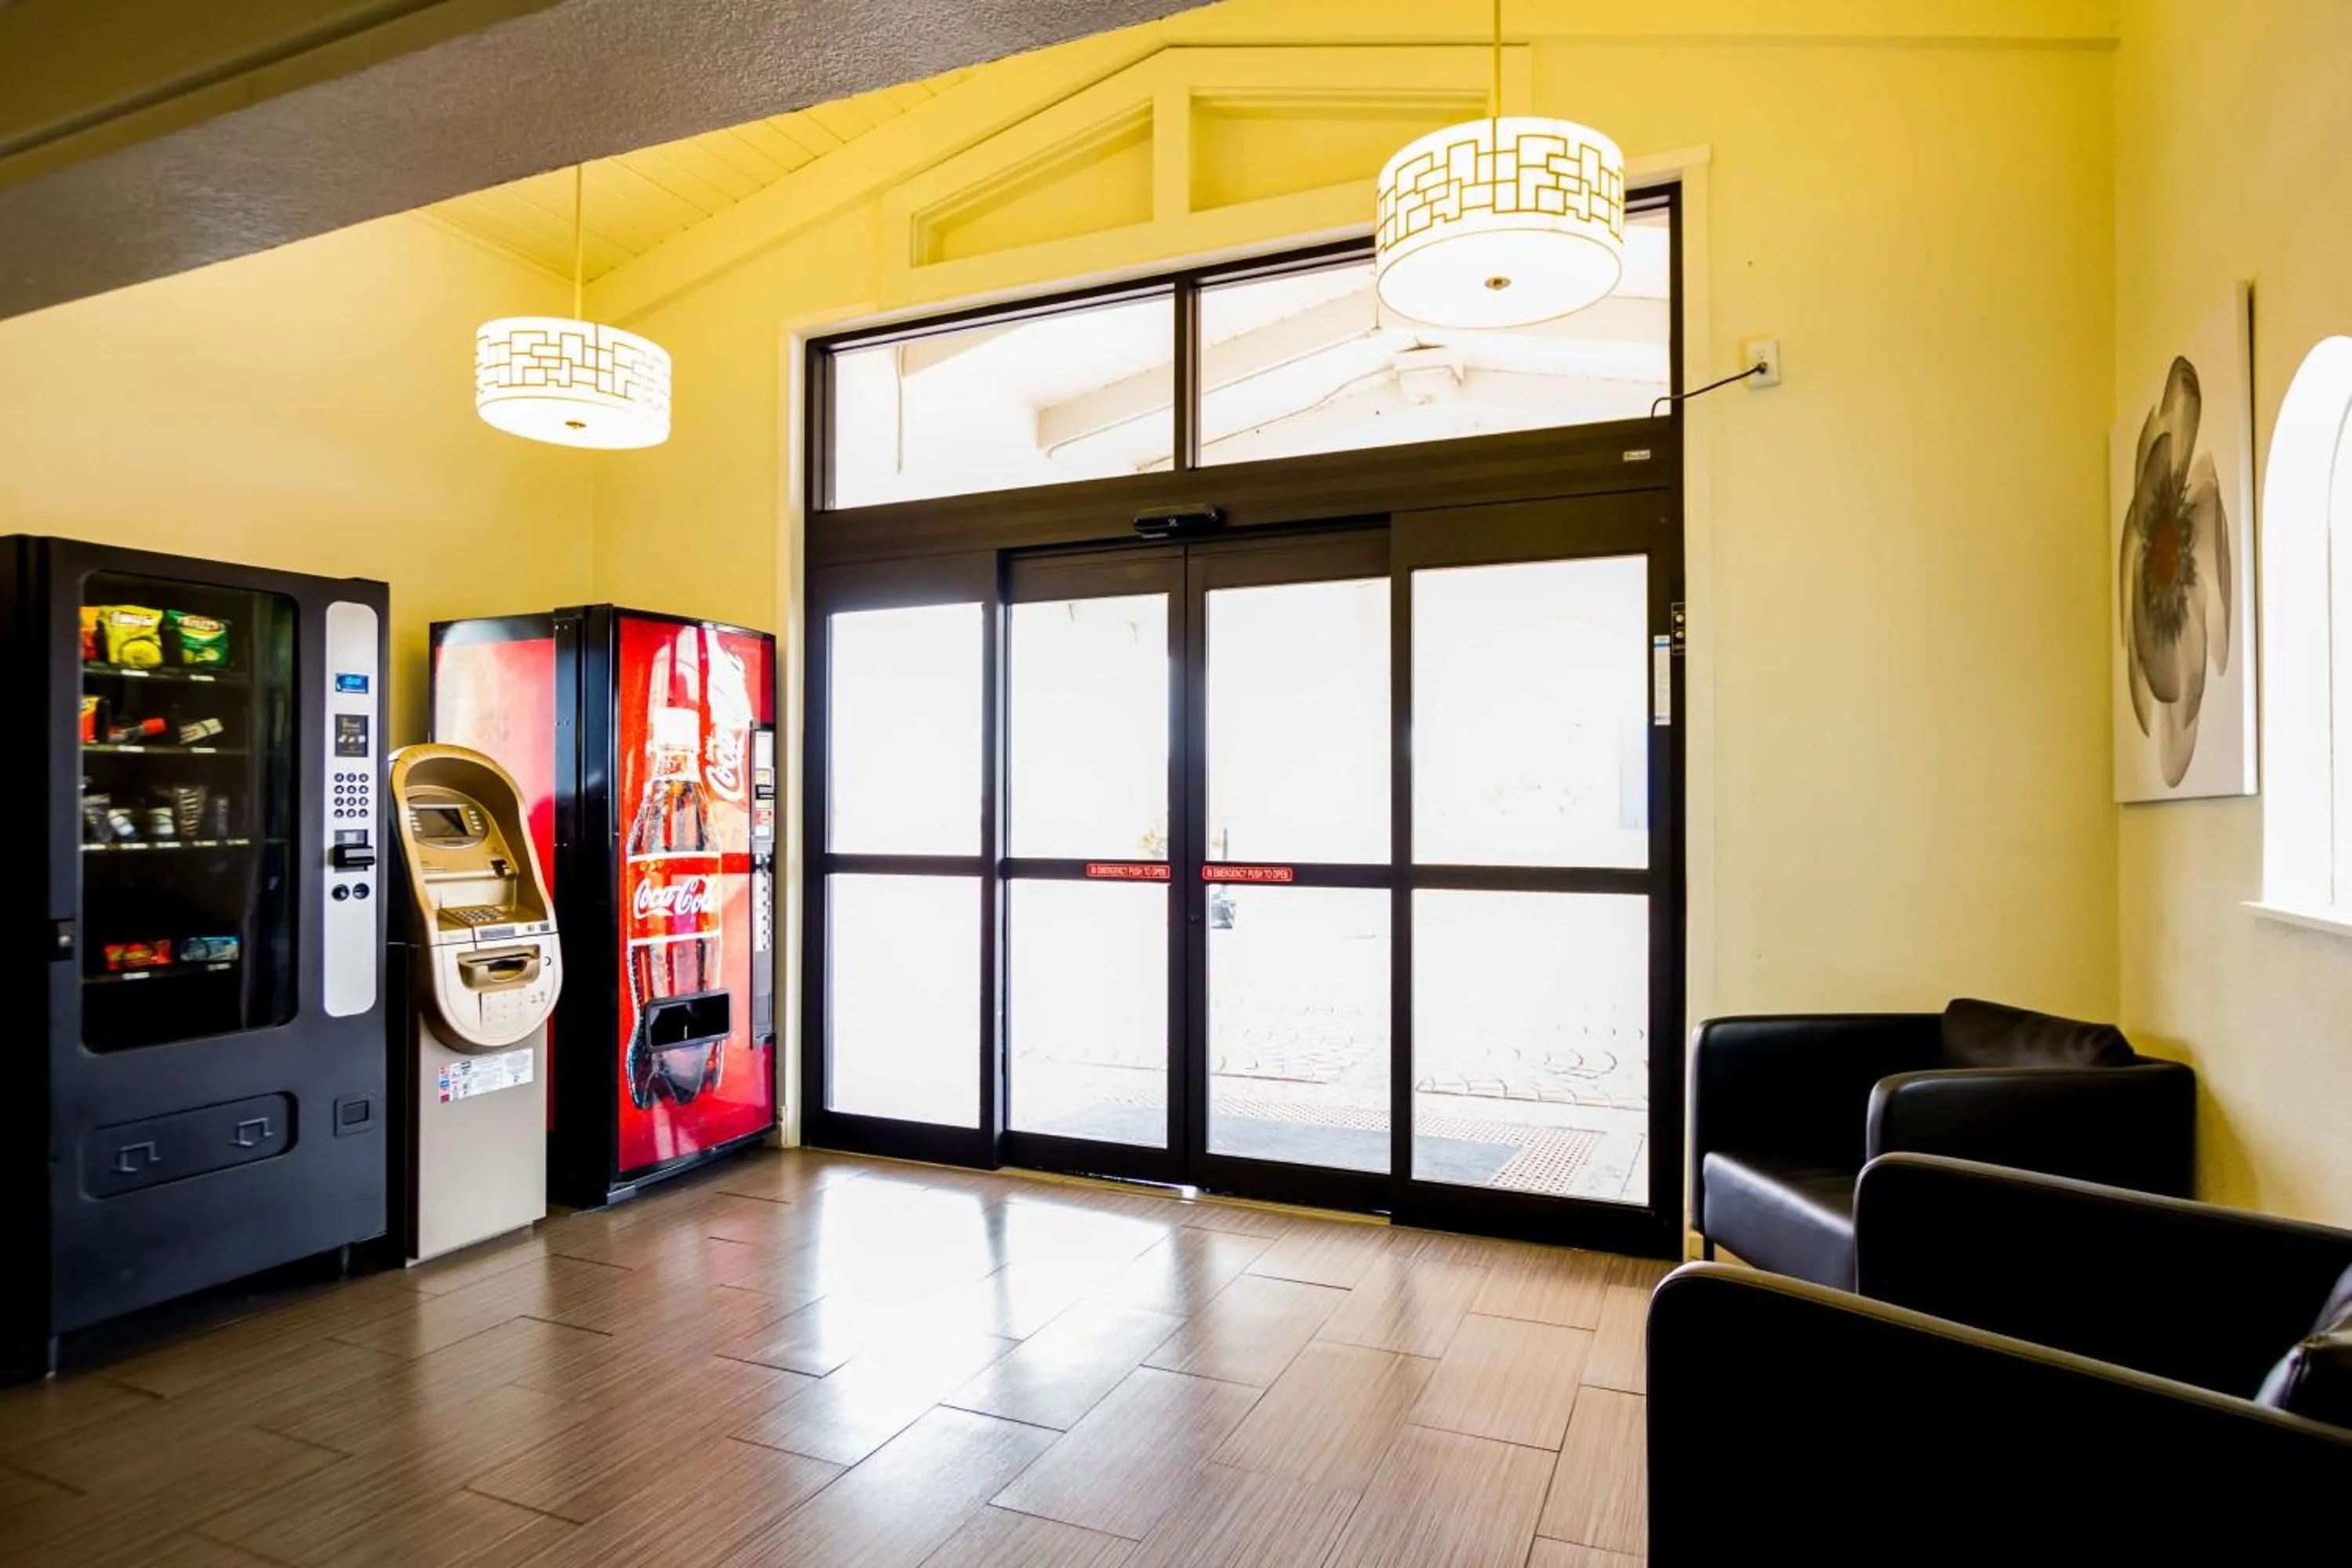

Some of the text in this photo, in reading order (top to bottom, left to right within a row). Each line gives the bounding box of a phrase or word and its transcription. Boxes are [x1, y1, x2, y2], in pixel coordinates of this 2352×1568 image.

[1098, 866, 1127, 875] EMERGENCY
[1129, 867, 1142, 876] PUSH
[1152, 867, 1167, 877] OPEN
[1207, 868, 1288, 879] IN EMERGENCY PUSH TO OPEN
